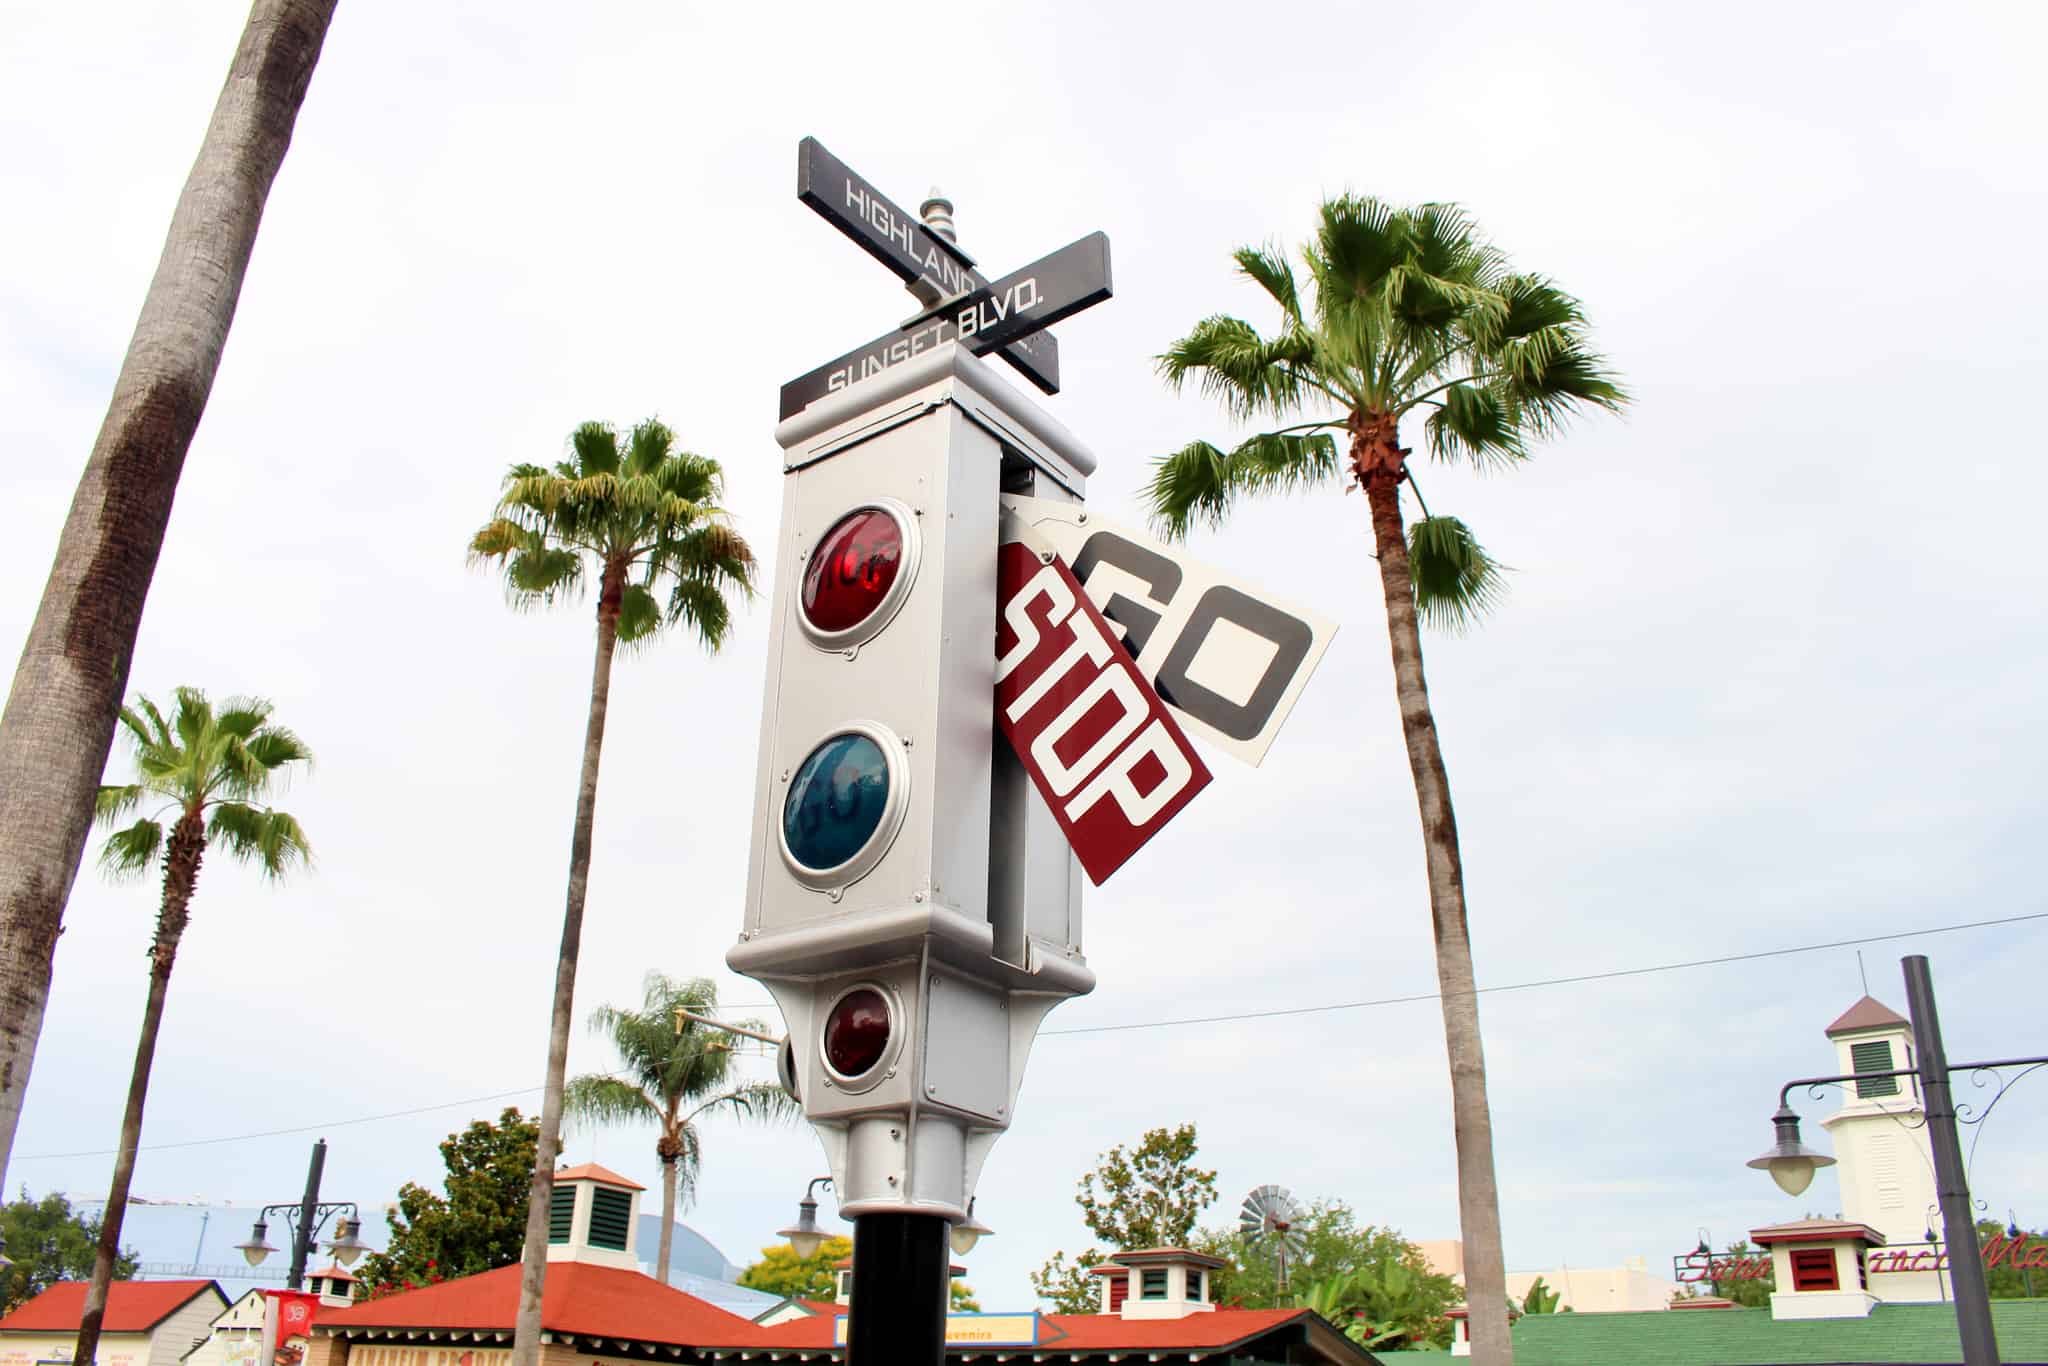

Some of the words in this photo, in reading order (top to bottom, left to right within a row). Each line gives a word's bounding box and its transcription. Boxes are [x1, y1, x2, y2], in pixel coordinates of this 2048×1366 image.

[846, 177, 976, 295] HIGHLAND
[827, 320, 955, 392] SUNSET
[957, 277, 1044, 340] BLVD.
[994, 565, 1193, 827] STOP
[1070, 530, 1313, 742] GO
